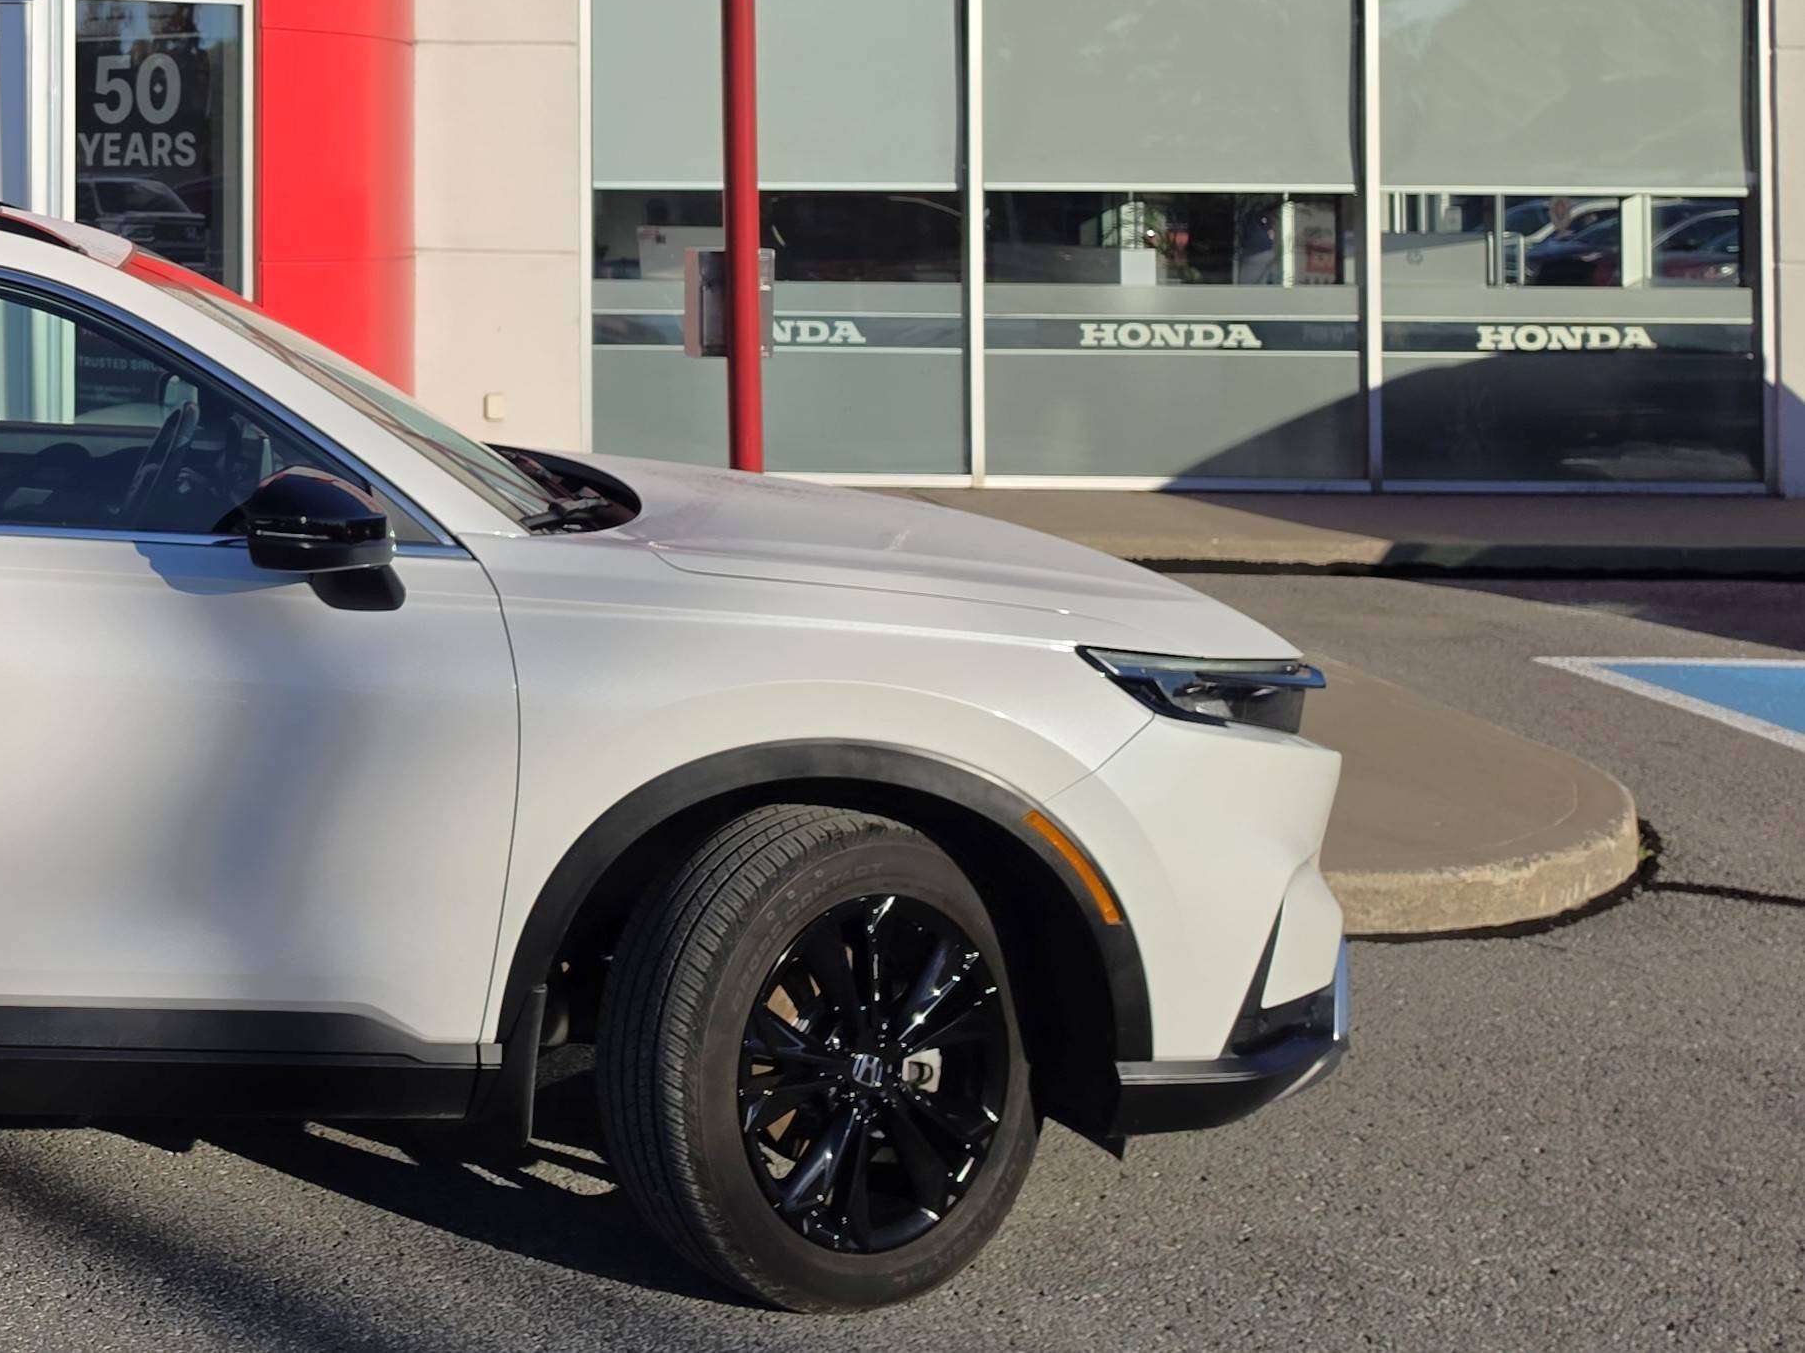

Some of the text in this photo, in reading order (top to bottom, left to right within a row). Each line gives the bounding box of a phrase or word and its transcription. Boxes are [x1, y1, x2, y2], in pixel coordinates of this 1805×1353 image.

[93, 52, 181, 125] 50
[78, 131, 197, 167] YEARS
[773, 320, 867, 344] NDA
[1079, 323, 1262, 348] HONDA
[1476, 324, 1657, 351] HONDA
